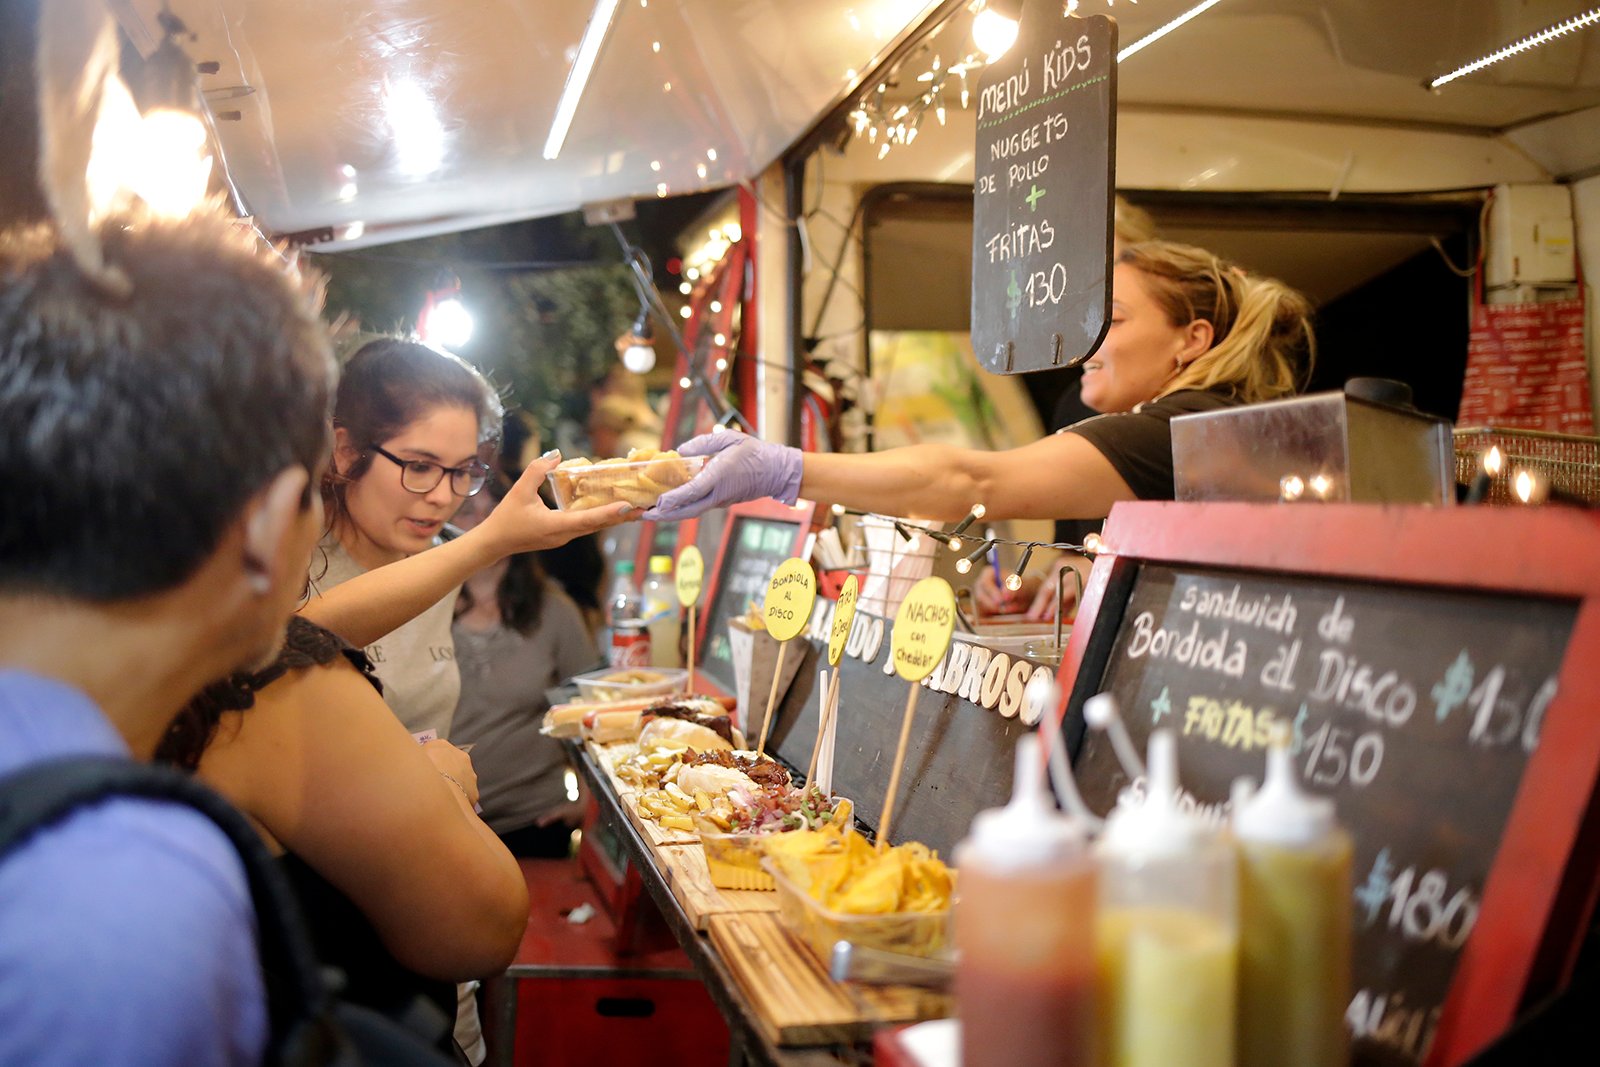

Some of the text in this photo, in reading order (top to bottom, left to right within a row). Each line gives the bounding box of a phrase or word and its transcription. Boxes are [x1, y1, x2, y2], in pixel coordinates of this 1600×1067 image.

[978, 58, 1030, 121] MENÚ
[979, 155, 1050, 195] DE POLLO
[783, 590, 792, 601] AL
[906, 602, 950, 627] NACHOS
[910, 631, 926, 644] con
[1317, 596, 1355, 642] de
[1127, 611, 1248, 680] Bondiola
[1260, 640, 1303, 692] al
